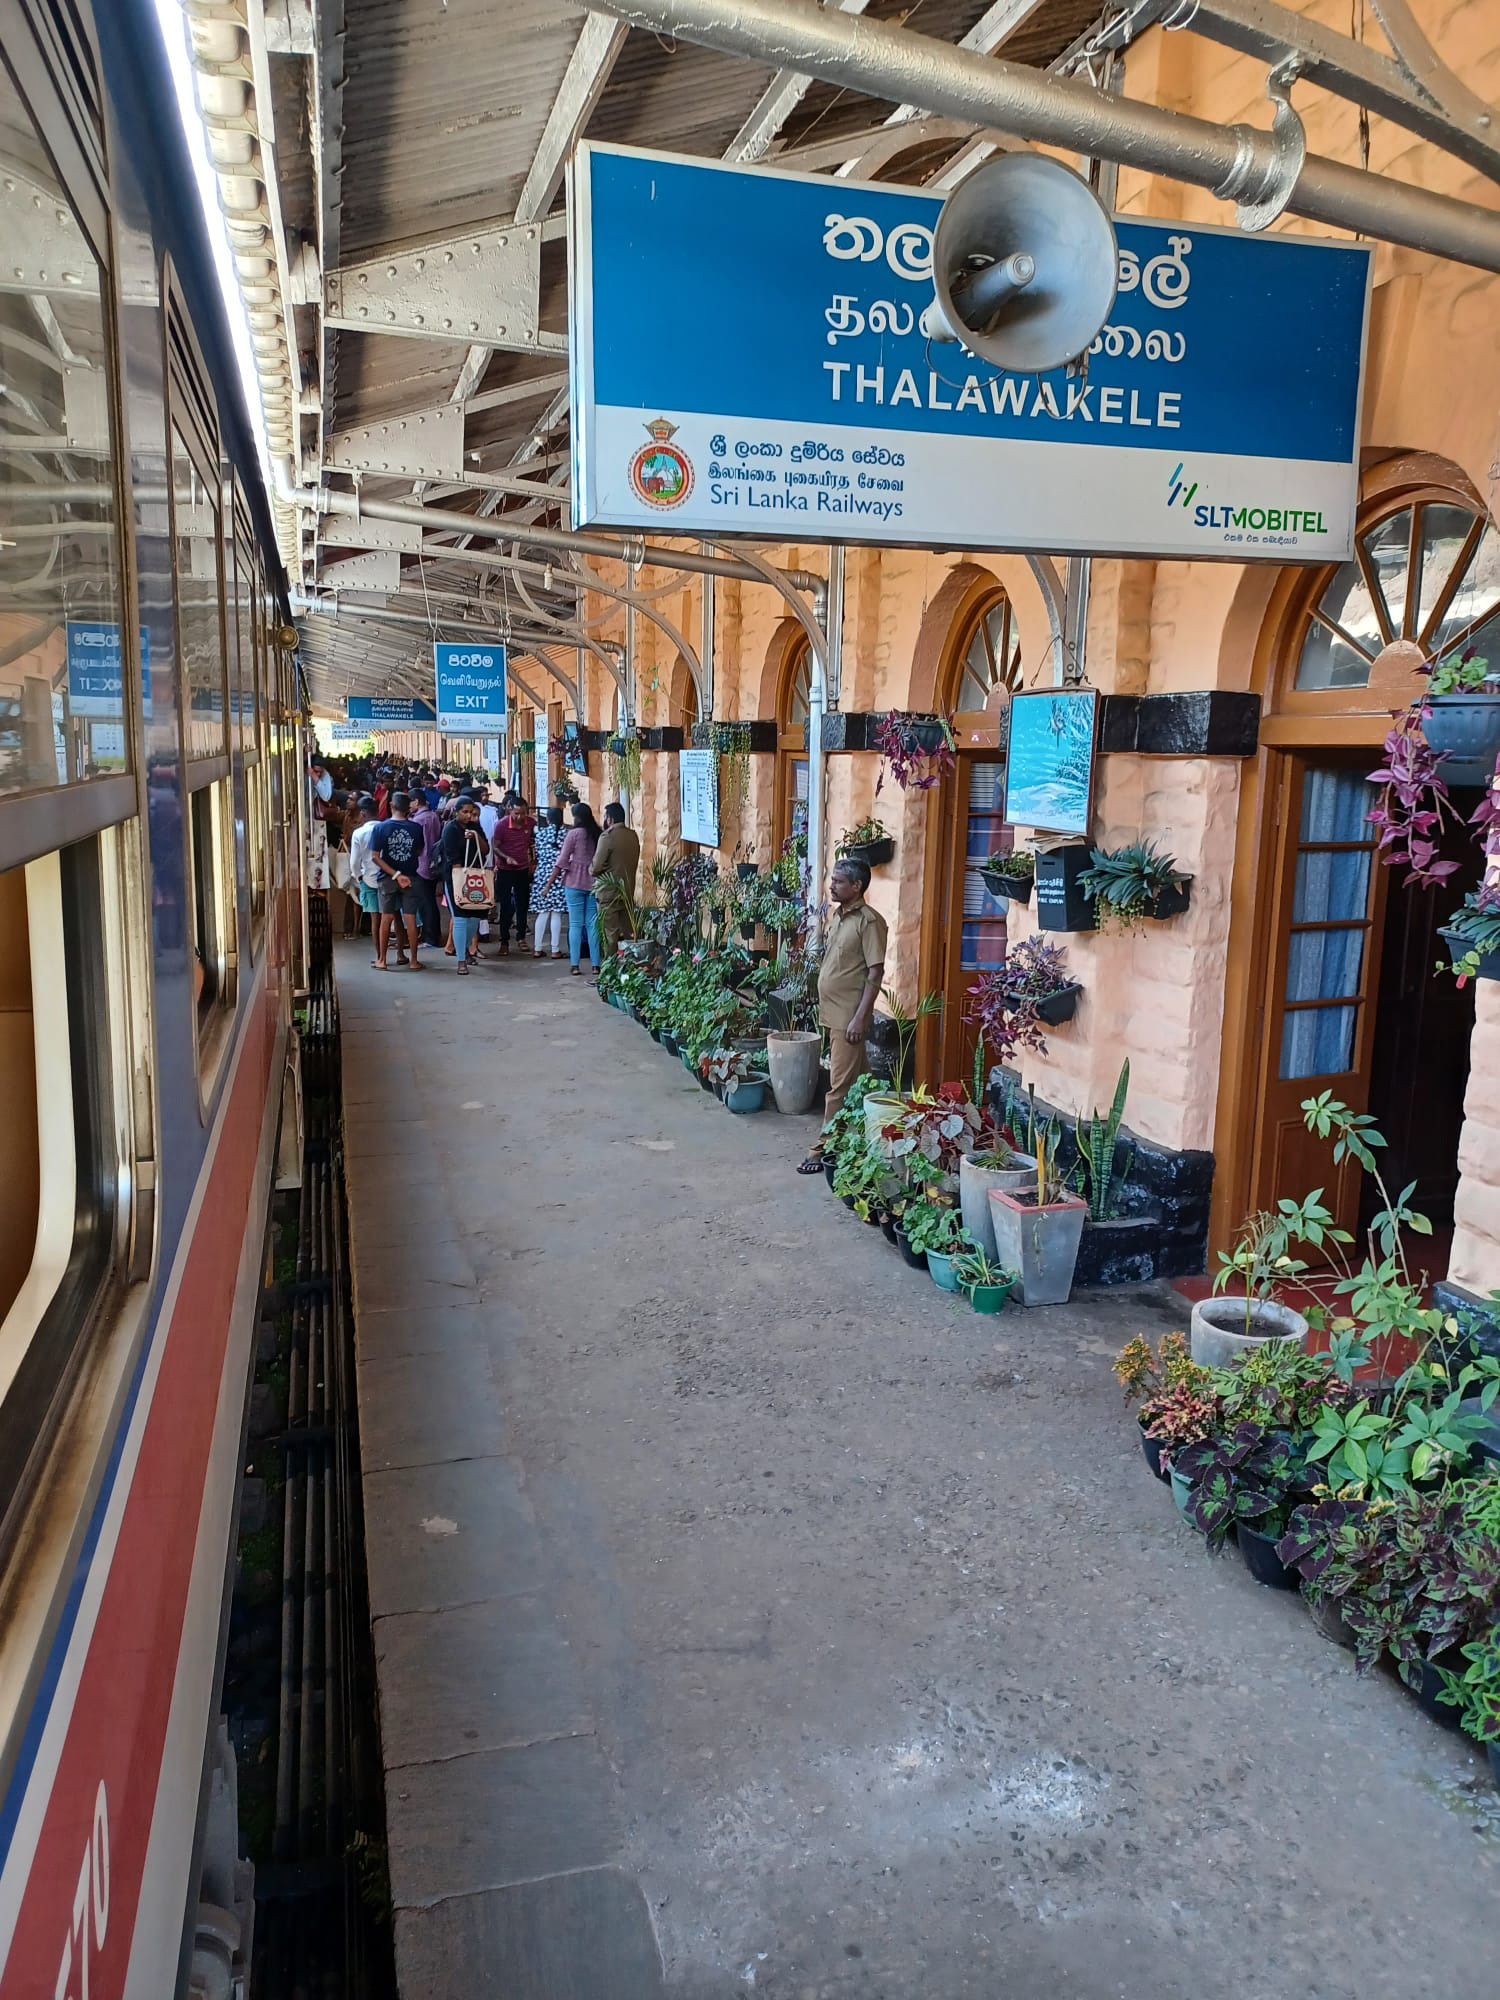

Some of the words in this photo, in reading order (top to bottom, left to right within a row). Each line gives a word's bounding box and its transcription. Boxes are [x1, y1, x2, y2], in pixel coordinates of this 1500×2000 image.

[822, 361, 1183, 429] THALAWAKELE
[735, 441, 783, 458] ලංකා
[790, 441, 845, 463] දුම්රිය
[852, 446, 906, 467] සේවය
[708, 461, 777, 482] இலங்கை
[858, 472, 904, 491] சேவை
[710, 483, 739, 506] Sri
[748, 486, 809, 511] Lanka
[817, 491, 904, 522] Railways
[455, 695, 489, 708] EXIT
